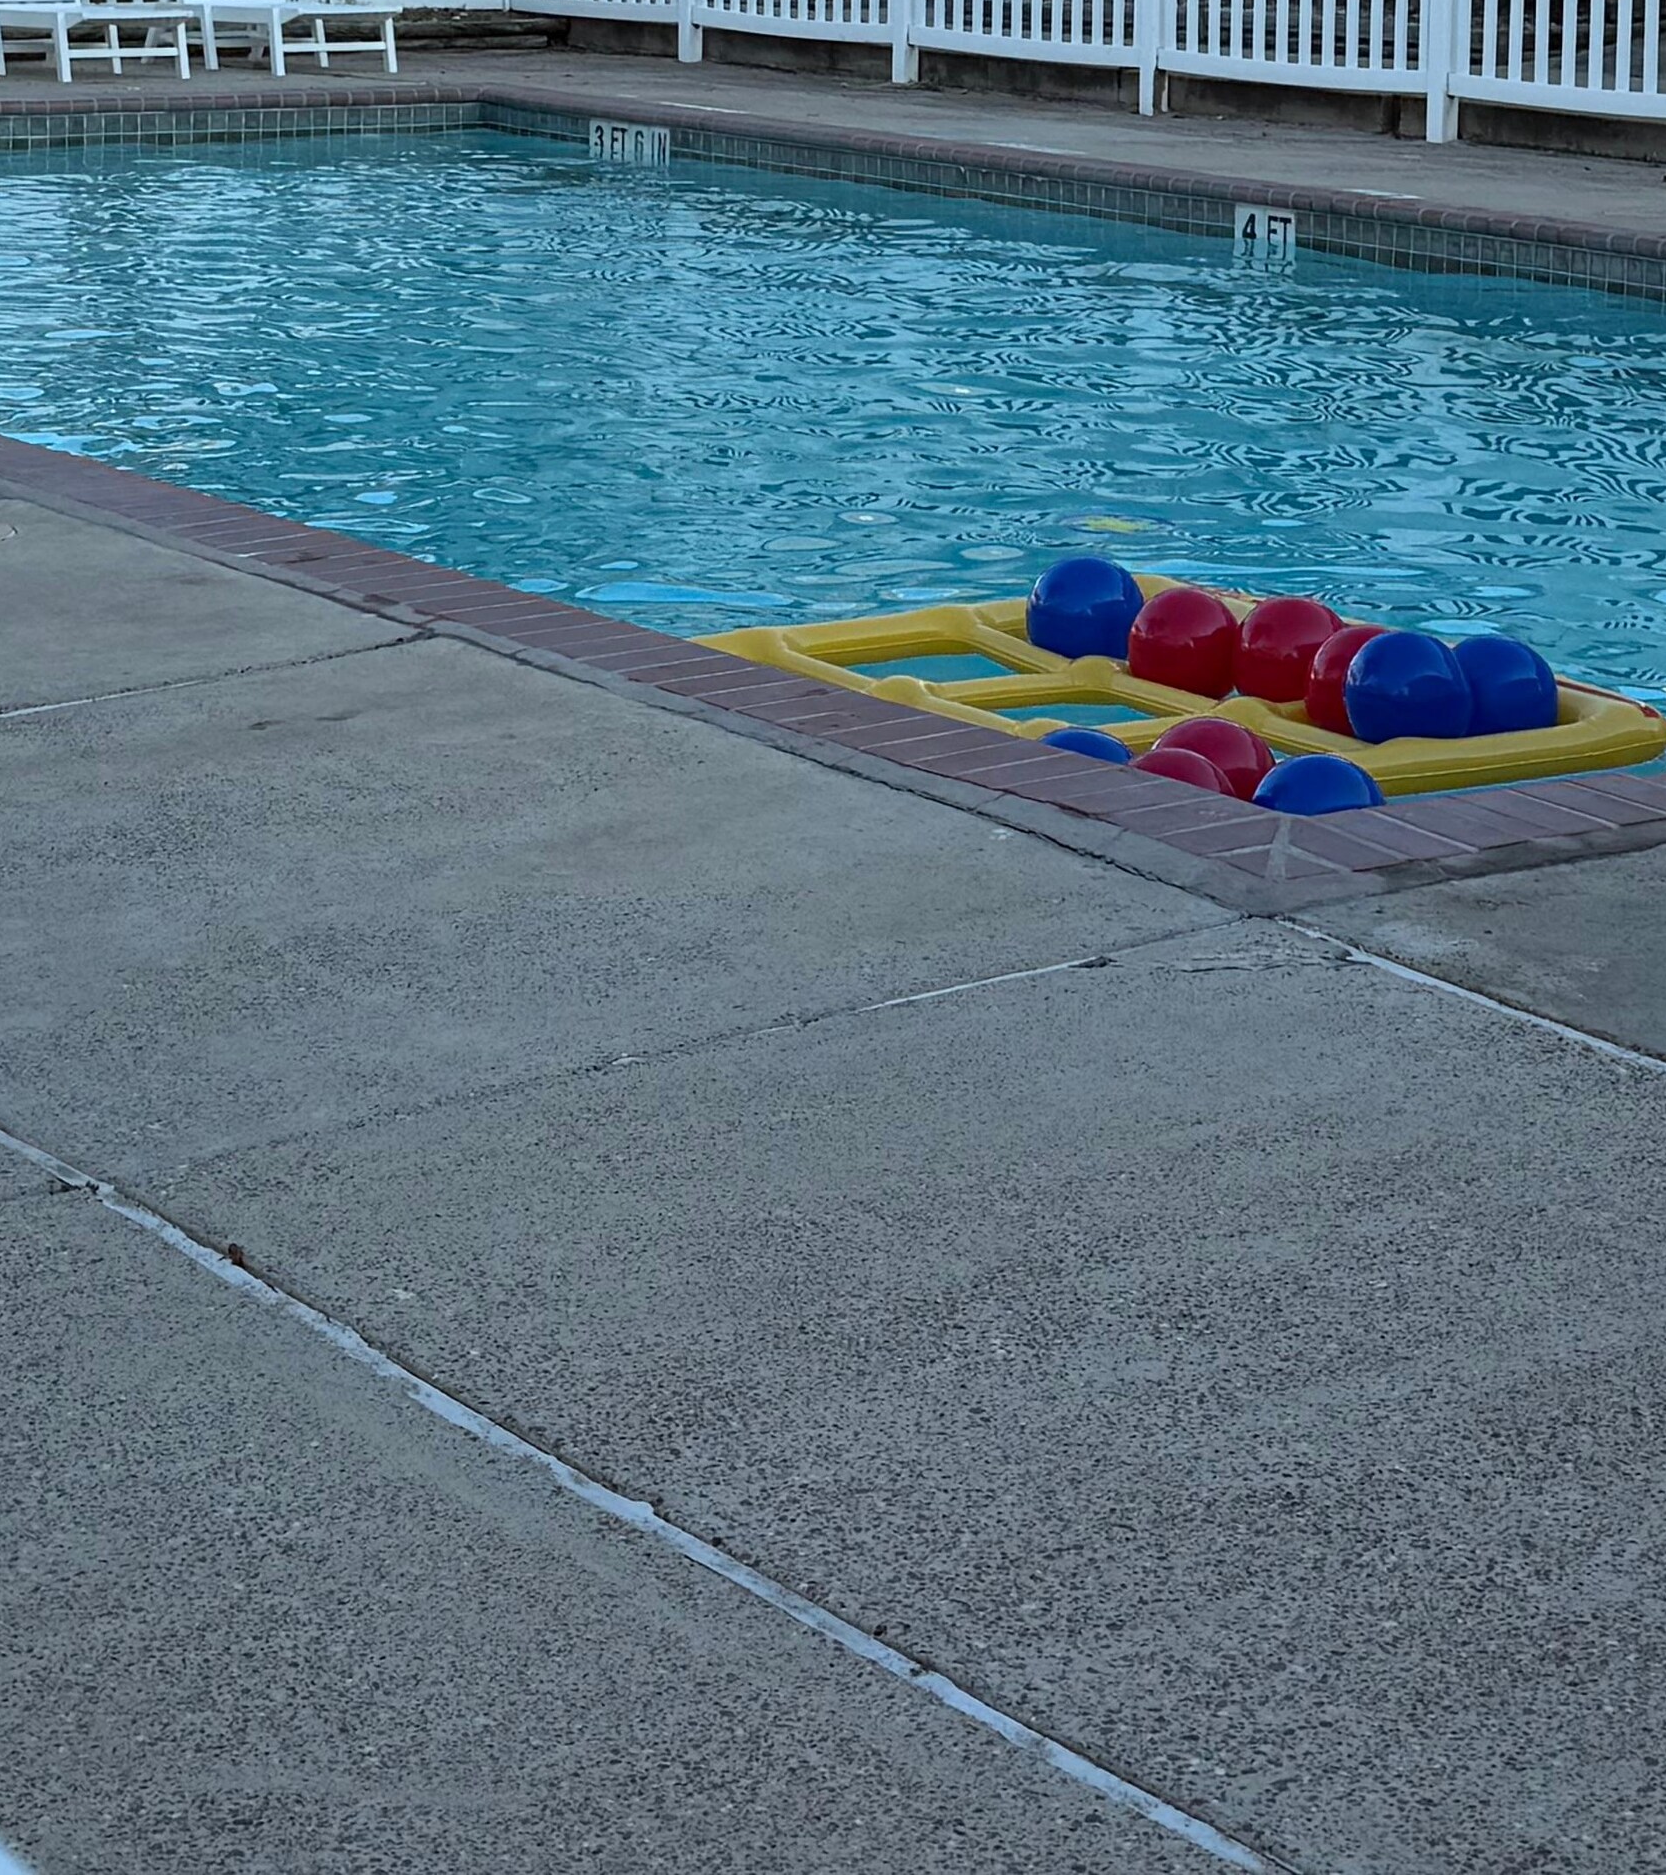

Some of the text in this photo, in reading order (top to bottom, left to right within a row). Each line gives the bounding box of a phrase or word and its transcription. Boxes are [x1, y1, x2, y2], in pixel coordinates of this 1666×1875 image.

[594, 125, 604, 159] 3
[1242, 213, 1292, 258] 4 FT
